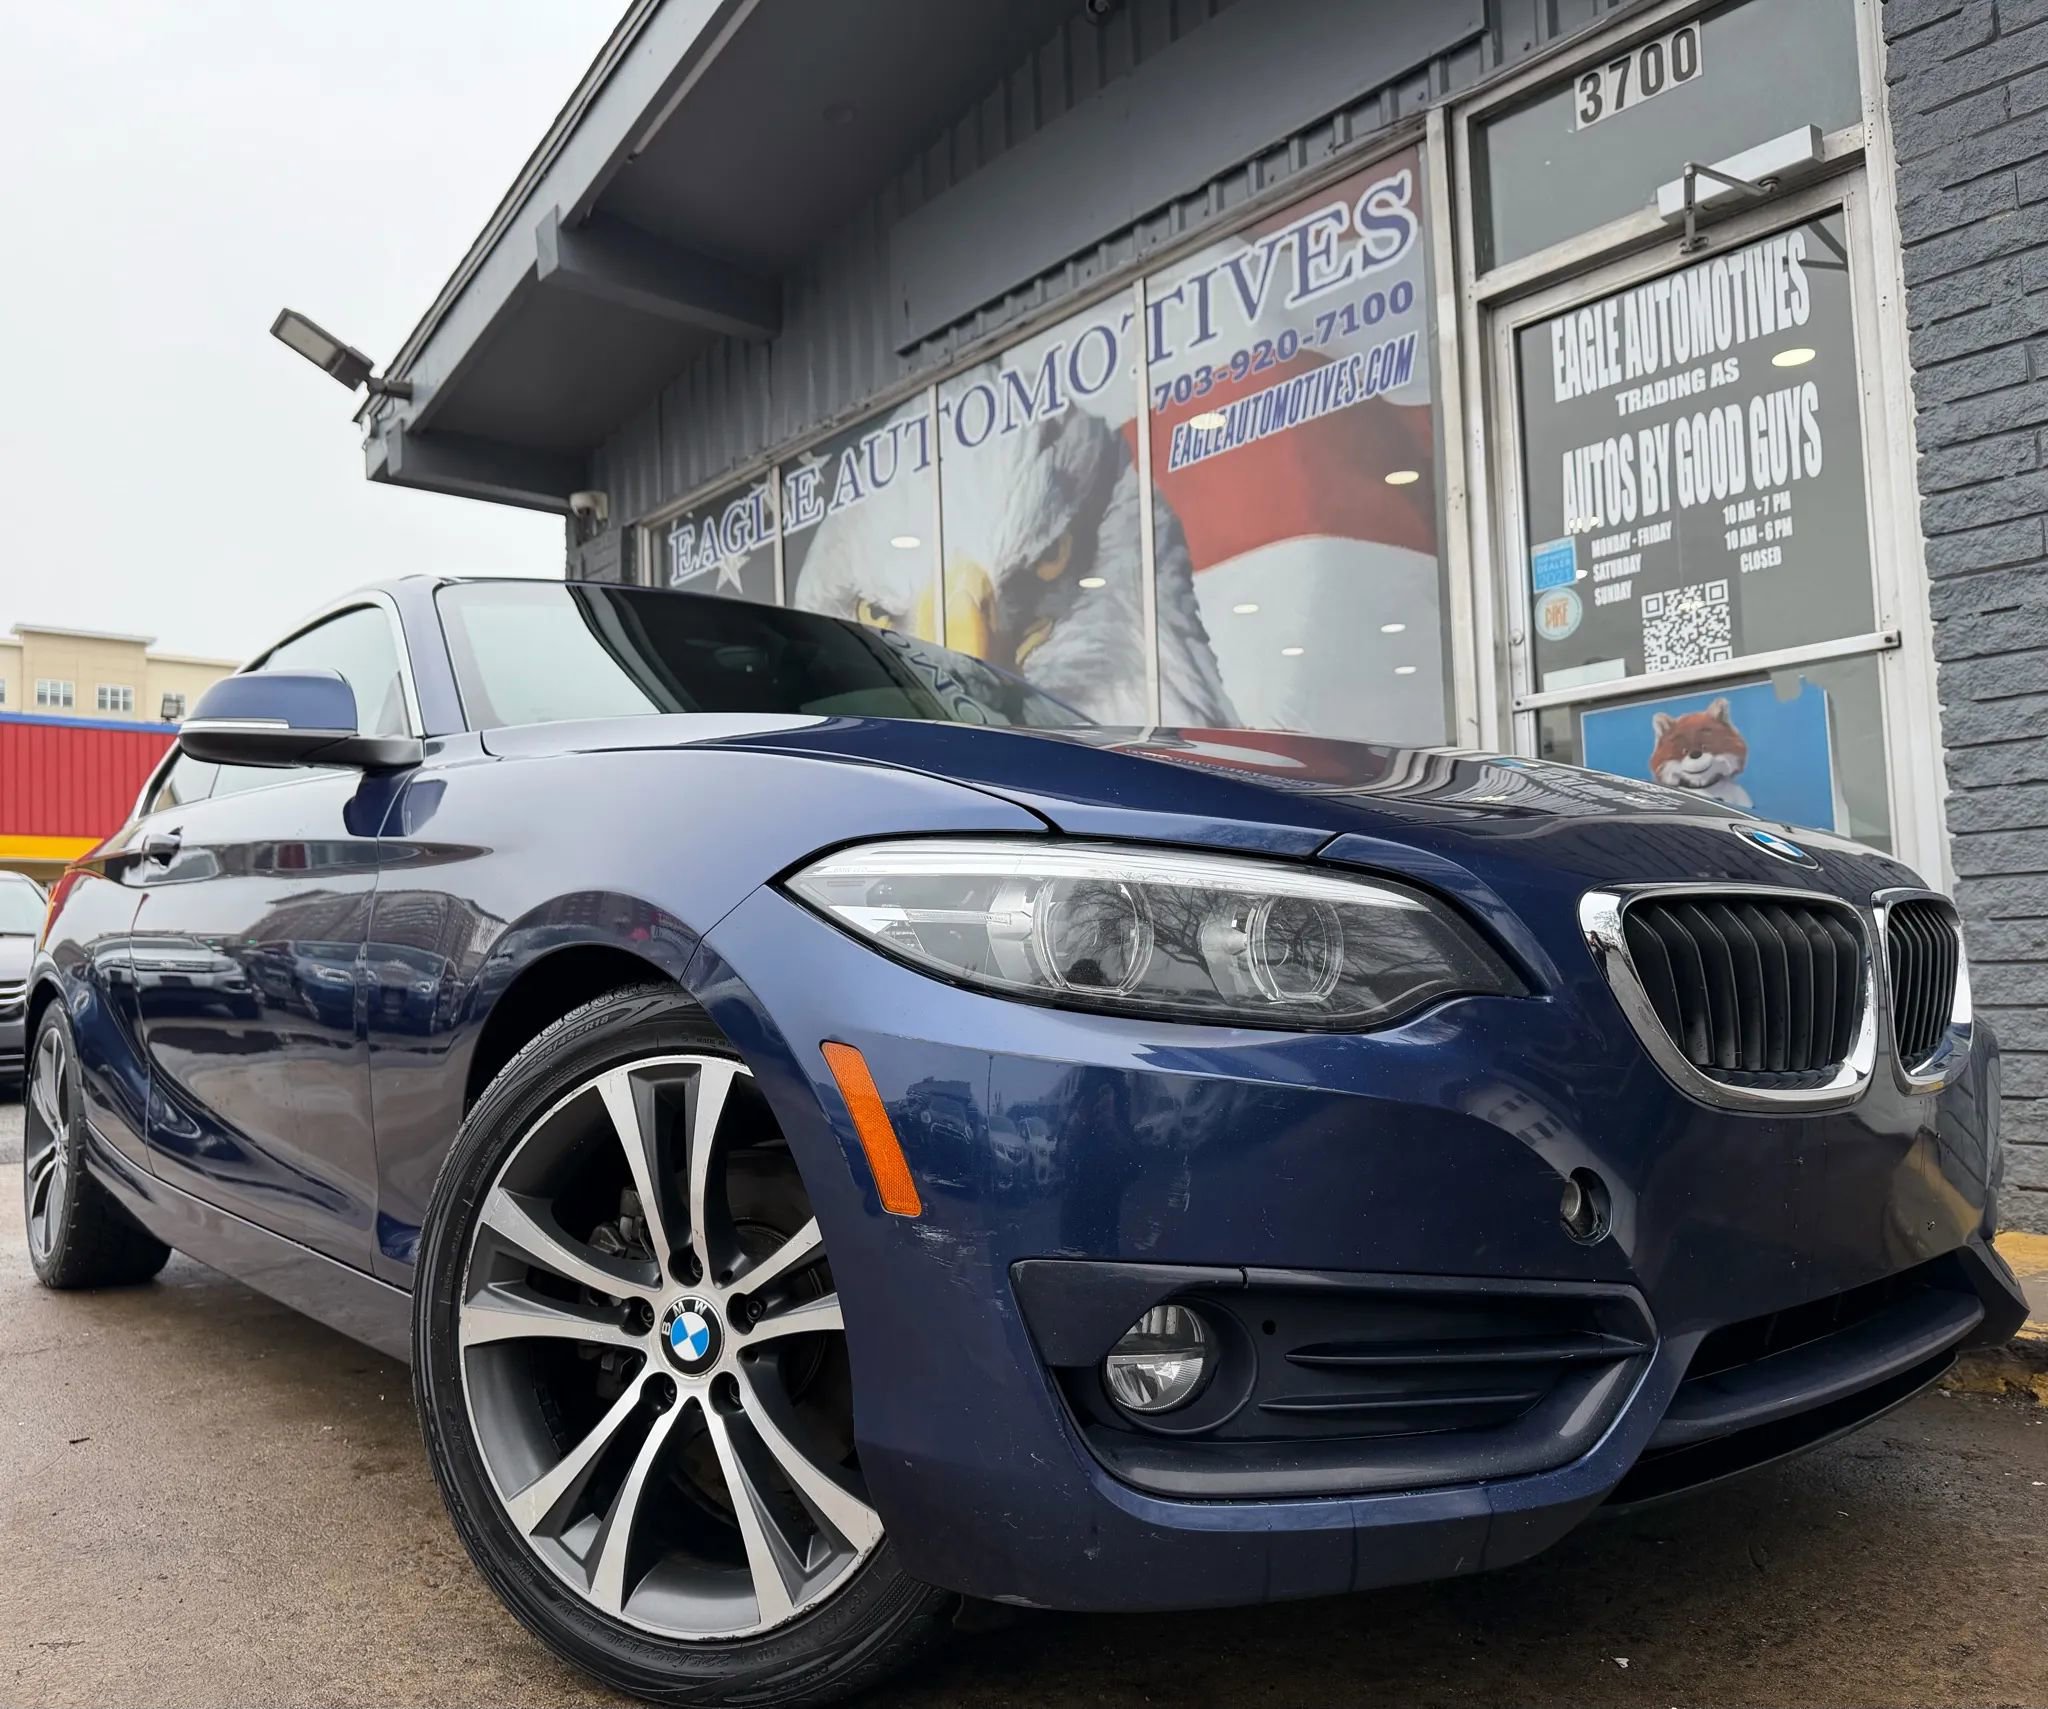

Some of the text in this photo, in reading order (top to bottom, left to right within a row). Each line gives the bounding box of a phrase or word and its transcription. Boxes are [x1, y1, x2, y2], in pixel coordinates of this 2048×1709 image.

[1579, 27, 1697, 124] 3700
[1551, 231, 1811, 403] EAGLE AUTOMOTIVES
[1154, 280, 1414, 414] 703-920-7100
[669, 167, 1419, 586] EAGLE AUTOMOTIVES
[1615, 357, 1740, 417] TRADING AS
[1168, 332, 1419, 473] EAGLEAUTOMOTIVES.COM
[1562, 381, 1823, 536] AUTOS BY GOOD GUYS
[1723, 504, 1738, 526] 10
[1738, 499, 1756, 523] AM
[1762, 495, 1770, 516] 7
[1772, 490, 1791, 514] PM
[1591, 531, 1632, 559] MONDAY
[1637, 520, 1672, 548] FRIDAY
[1725, 530, 1739, 551] 10
[1739, 525, 1758, 548] AM
[1764, 520, 1774, 542] 6
[1774, 515, 1793, 540] PM
[1593, 553, 1642, 583] SATURDAY
[1740, 546, 1782, 574] CLOSED
[1594, 580, 1633, 607] SUNDAY
[661, 1300, 708, 1336] BMW
